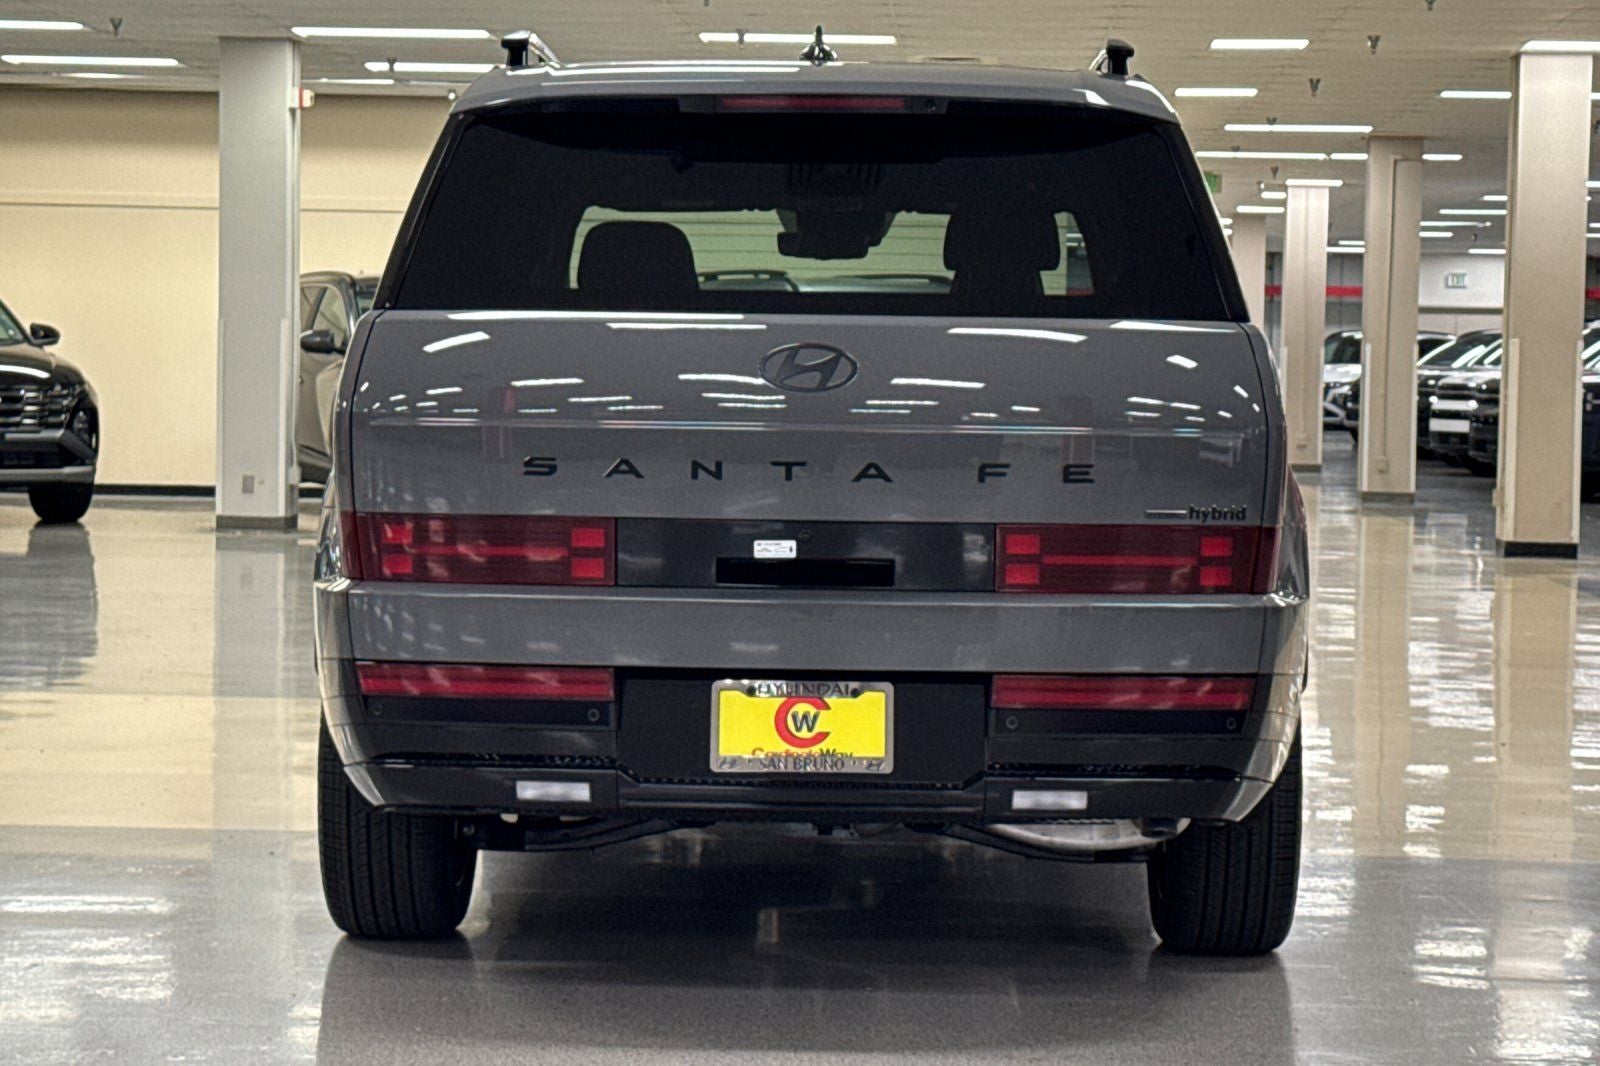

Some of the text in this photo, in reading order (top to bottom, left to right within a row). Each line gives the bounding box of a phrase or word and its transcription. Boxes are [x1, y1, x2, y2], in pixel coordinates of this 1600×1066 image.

[522, 455, 1095, 484] SANTA FE
[1189, 503, 1247, 523] hybrid
[757, 682, 850, 697] HYUNDAI
[759, 756, 845, 771] SAN BRUNO
